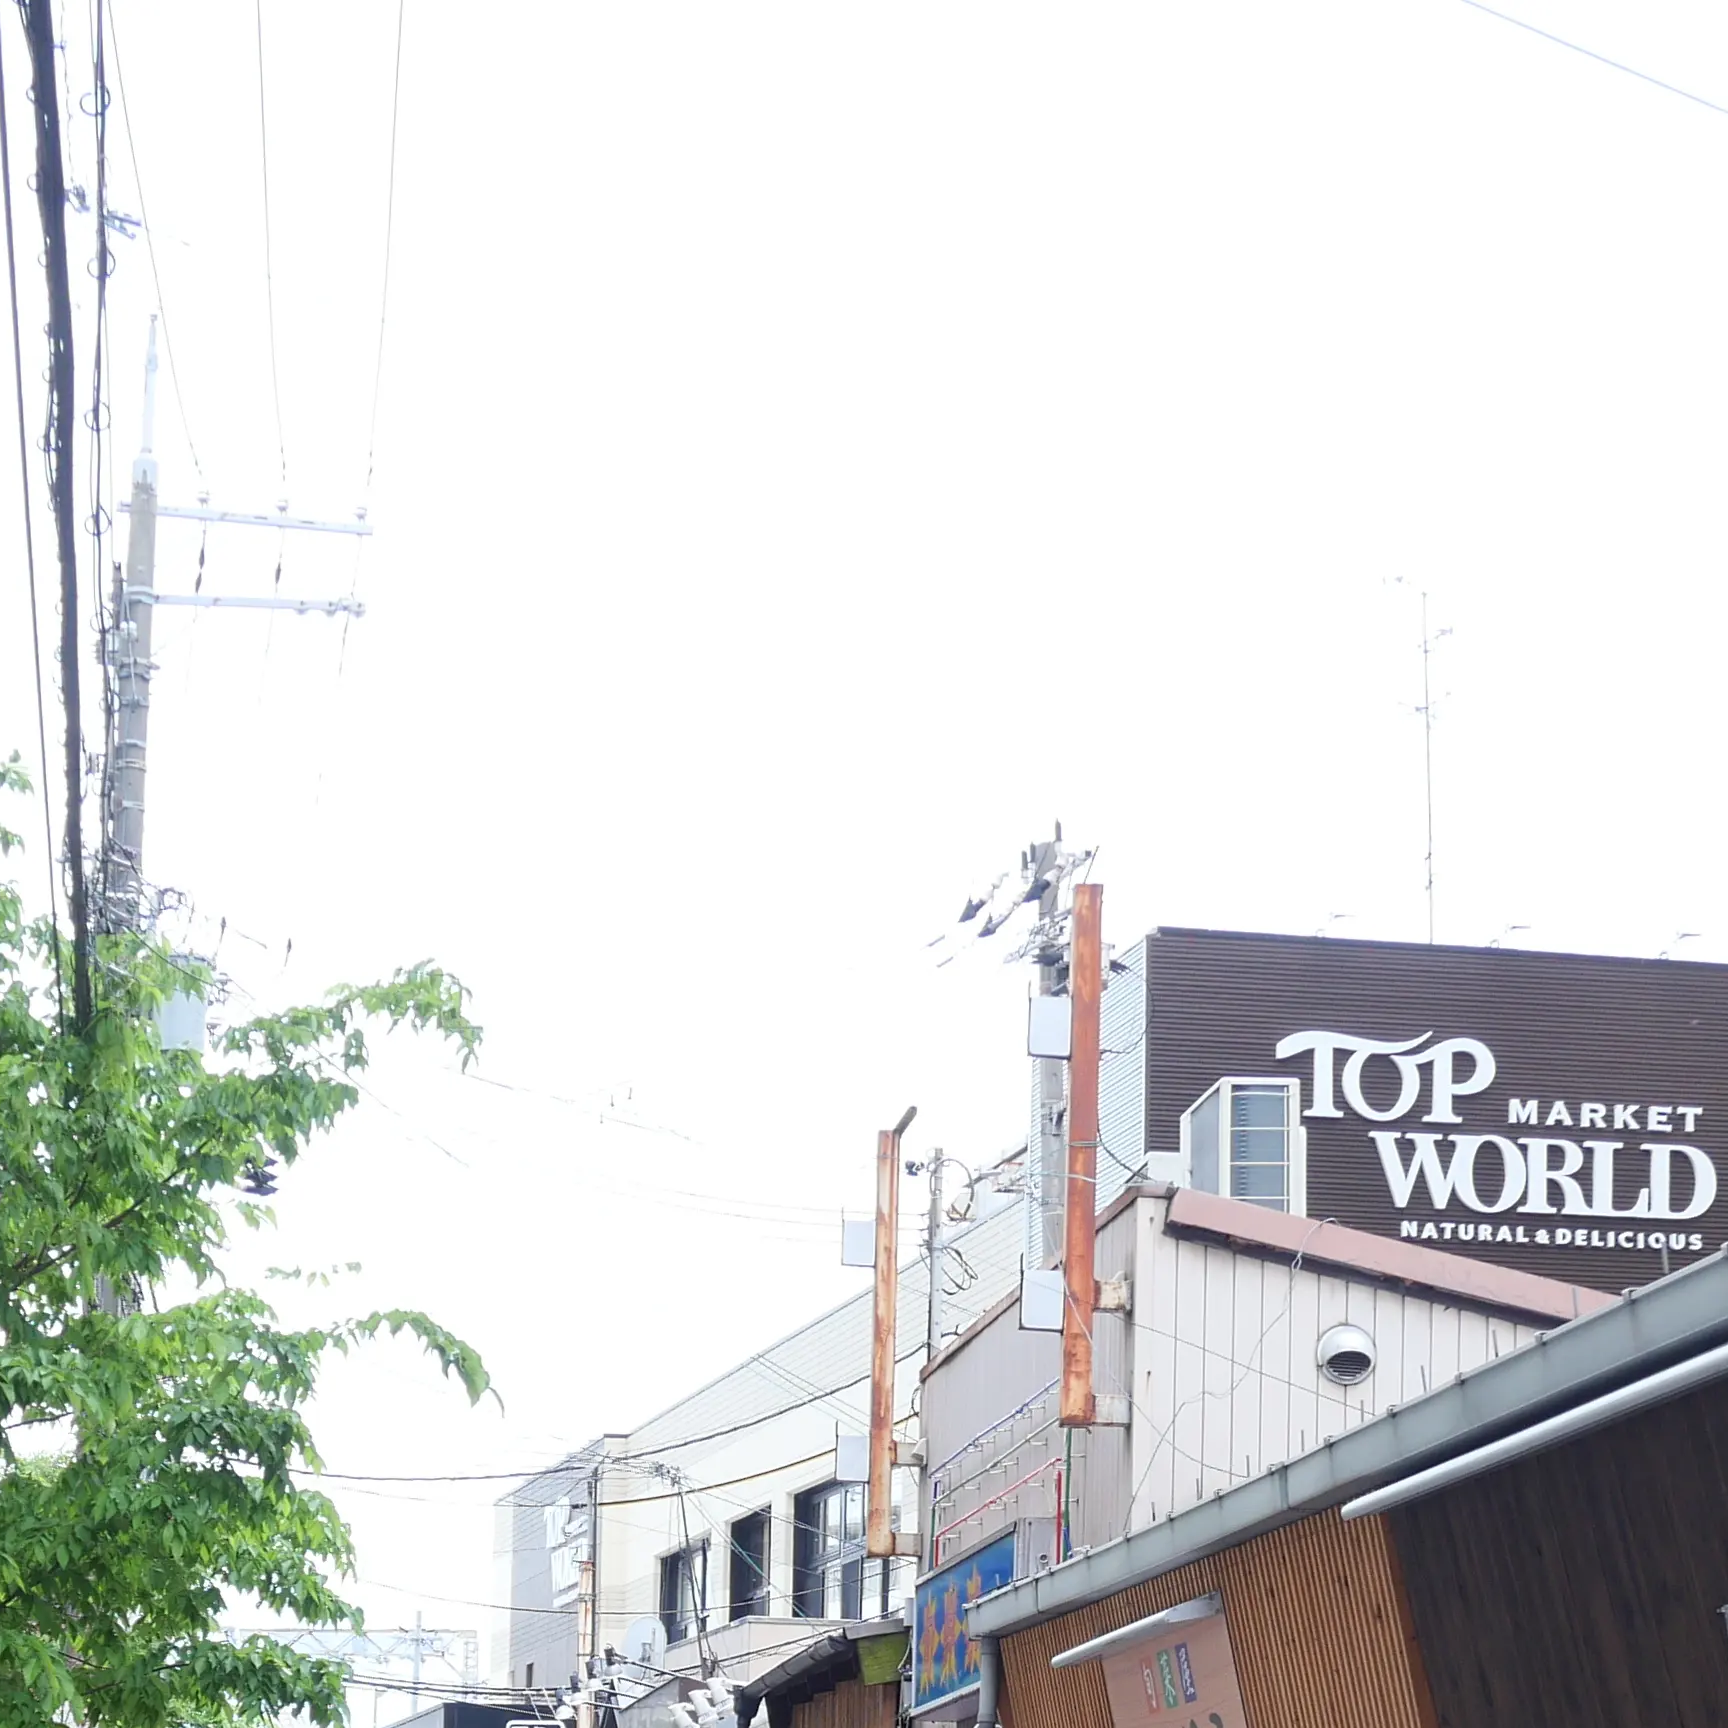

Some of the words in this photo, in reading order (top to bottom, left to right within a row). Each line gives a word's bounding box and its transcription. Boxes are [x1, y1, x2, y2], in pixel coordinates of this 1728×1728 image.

[1275, 1030, 1497, 1123] TOP
[1507, 1098, 1704, 1133] MARKET
[1368, 1130, 1717, 1221] WORLD
